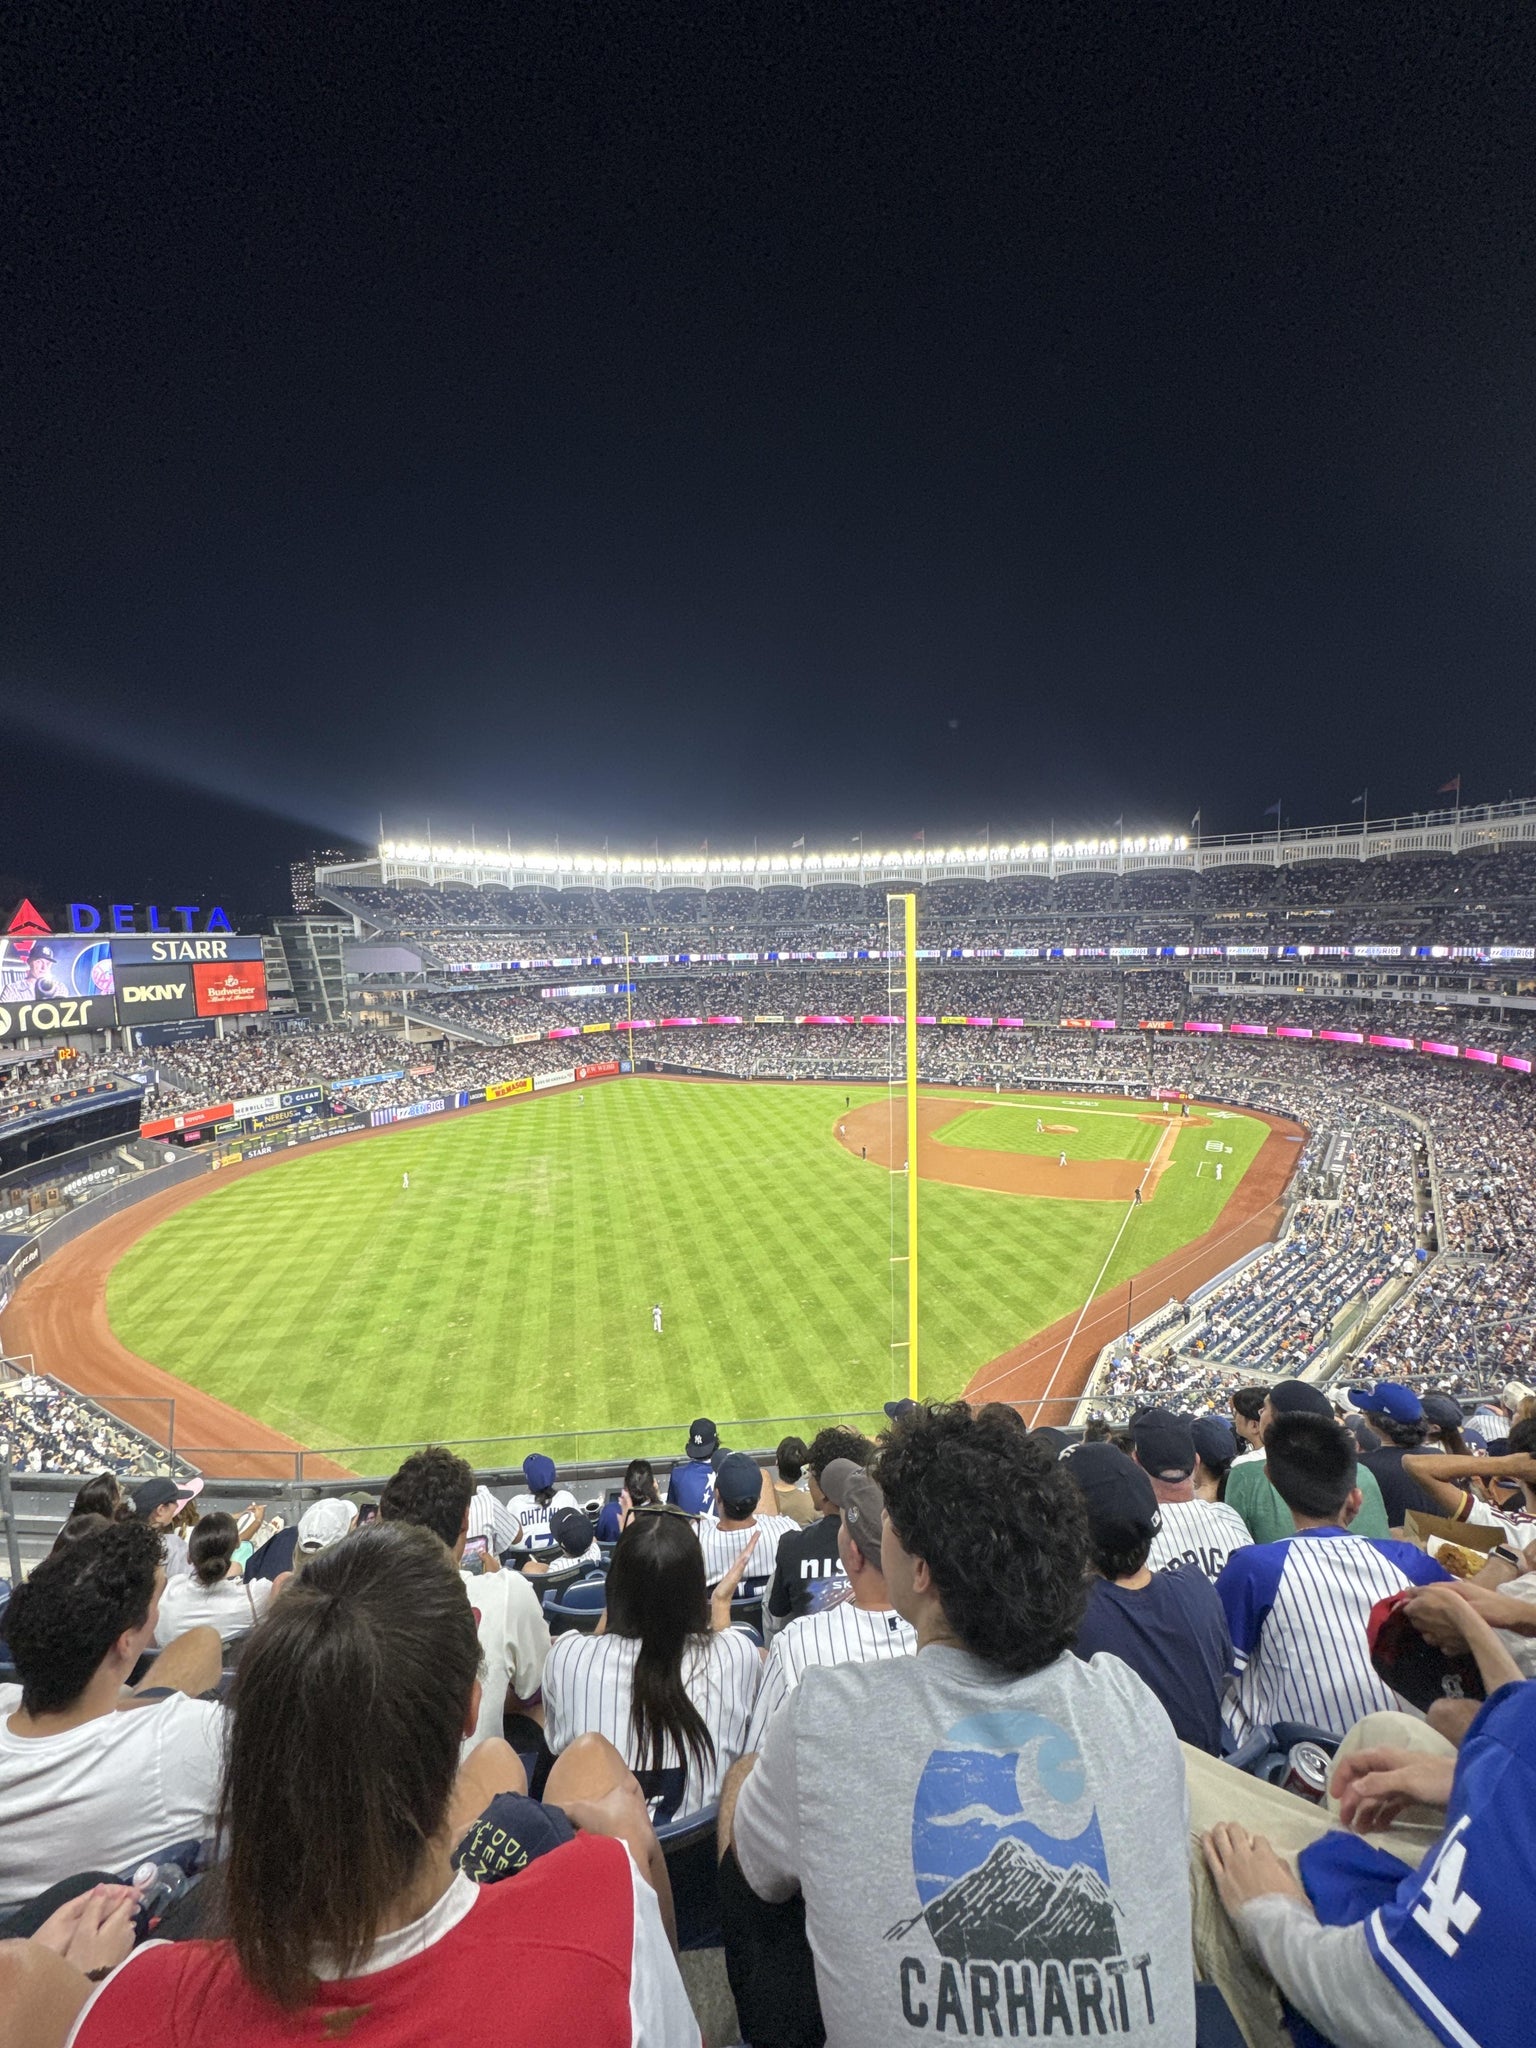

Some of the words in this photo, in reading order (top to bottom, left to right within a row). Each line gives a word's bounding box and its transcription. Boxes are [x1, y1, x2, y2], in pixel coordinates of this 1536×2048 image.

[67, 903, 233, 934] DELTA
[151, 940, 228, 961] STARR
[1516, 948, 1534, 957] RICE
[122, 983, 187, 1004] DKNY
[207, 986, 256, 997] Budweiser
[18, 1000, 94, 1032] razr
[1146, 1021, 1165, 1029] AVIS
[296, 1091, 319, 1101] CLEAR
[235, 1104, 264, 1113] MERRILL
[409, 1104, 426, 1116] BEN
[426, 1100, 444, 1112] RICE
[185, 1114, 205, 1123] TOYOTA
[264, 1110, 293, 1123] NEREUS
[248, 1146, 272, 1158] STARR
[520, 1507, 560, 1527] OHTAN
[899, 1951, 1156, 2038] CARHARTT
